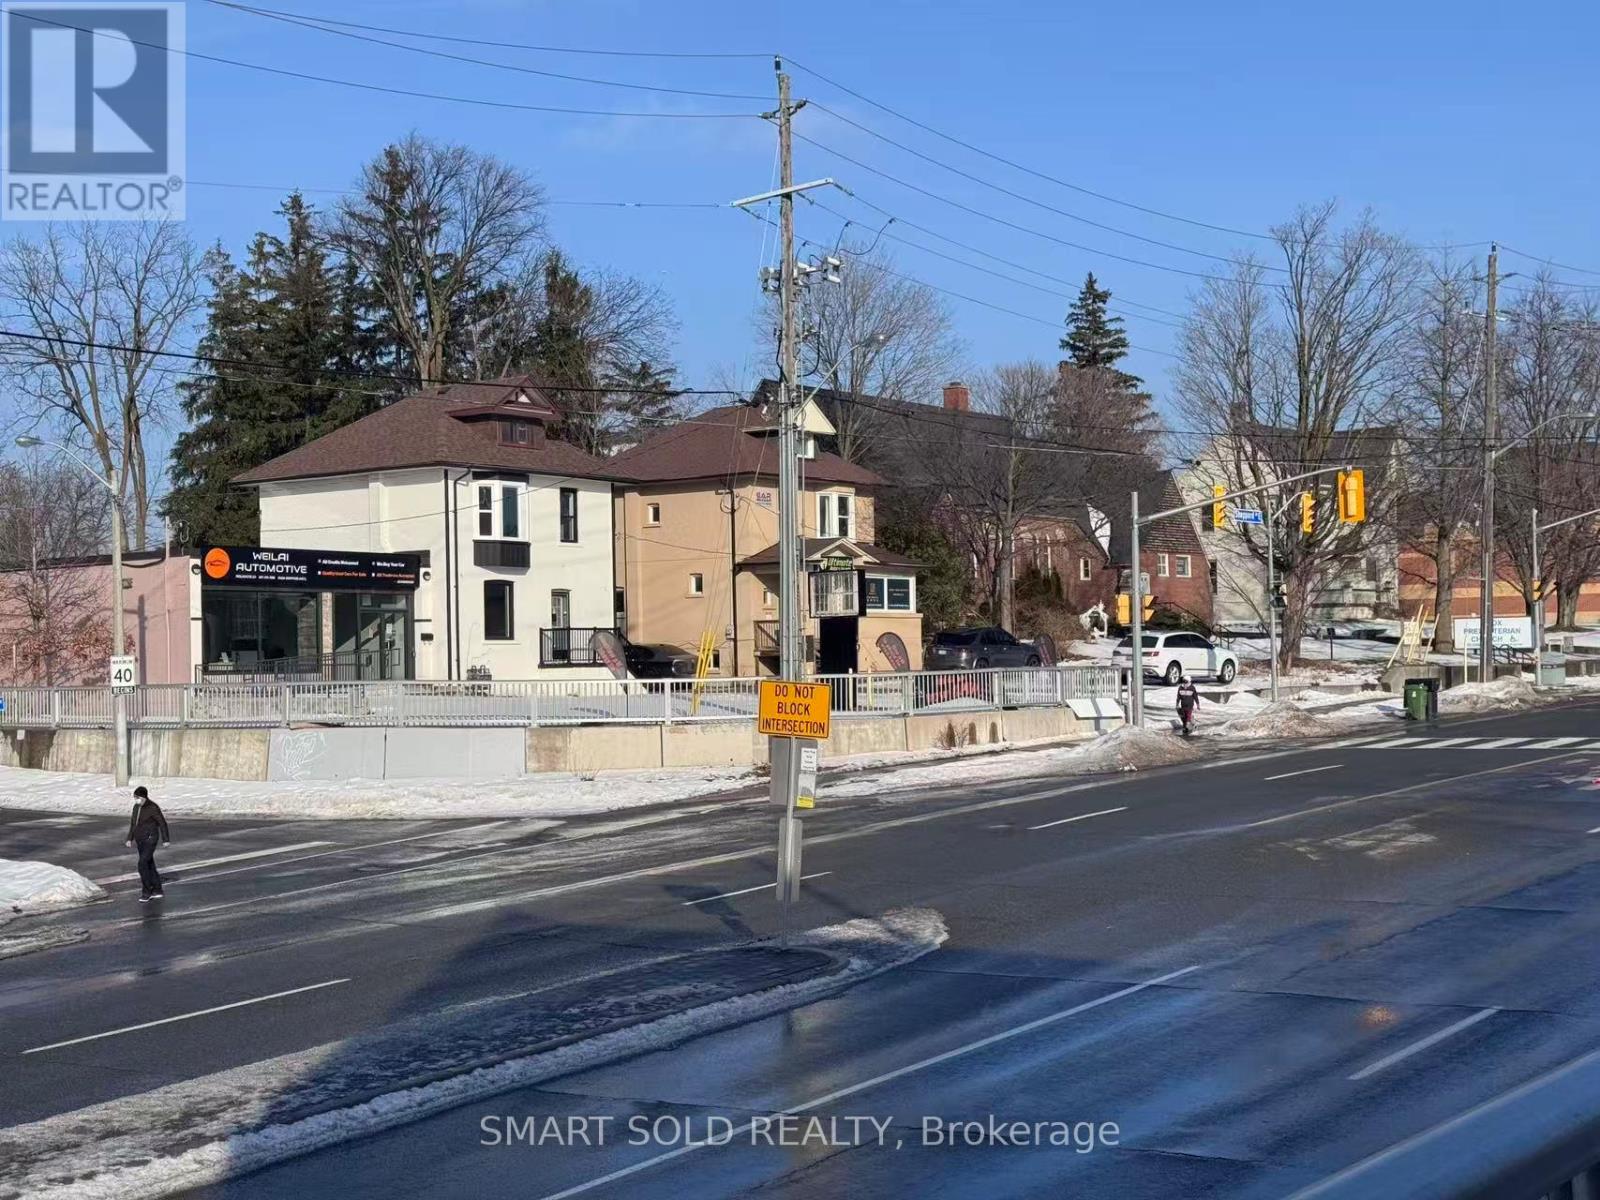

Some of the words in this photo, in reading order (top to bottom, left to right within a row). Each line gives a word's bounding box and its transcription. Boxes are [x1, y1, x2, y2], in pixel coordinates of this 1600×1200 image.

[253, 552, 289, 561] WEILAI
[236, 563, 307, 573] AUTOMOTIVE
[114, 668, 132, 682] 40
[775, 684, 788, 697] DO
[794, 685, 815, 699] NOT
[777, 702, 810, 716] BLOCK
[762, 718, 825, 734] INTERSECTION
